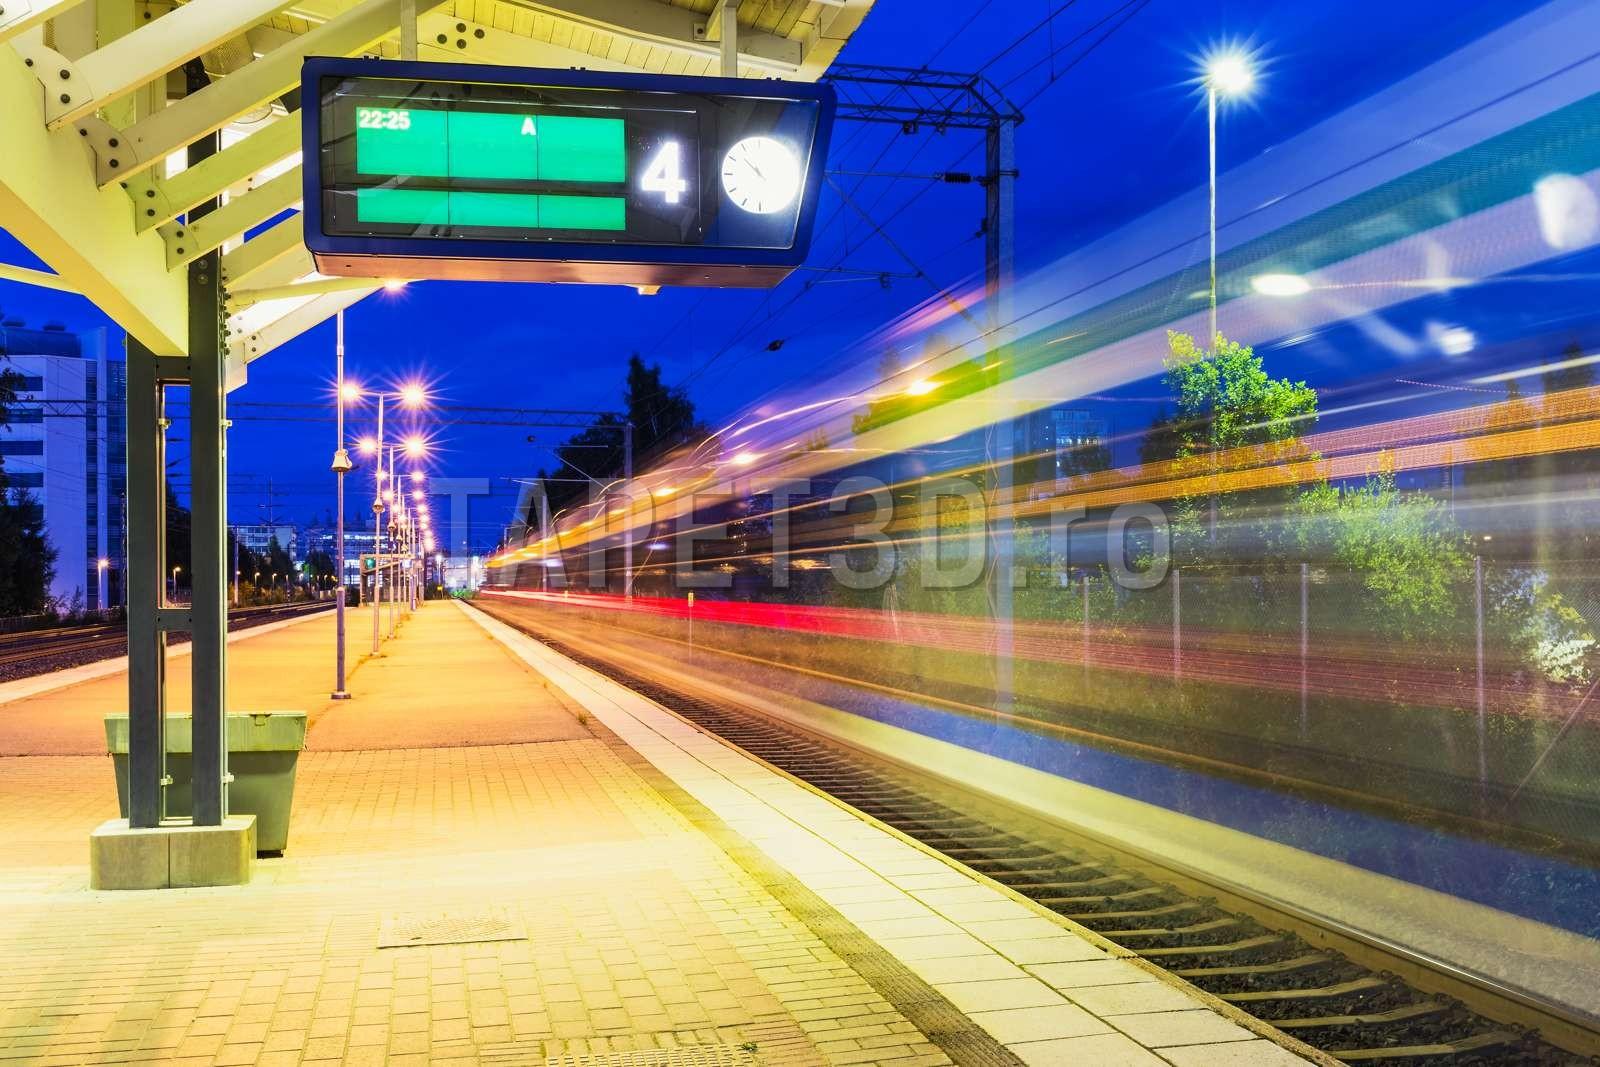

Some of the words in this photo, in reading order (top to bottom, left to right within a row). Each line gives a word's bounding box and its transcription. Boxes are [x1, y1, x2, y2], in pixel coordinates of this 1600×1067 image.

[359, 110, 411, 130] 22:25
[521, 117, 537, 136] A
[641, 141, 686, 204] 4
